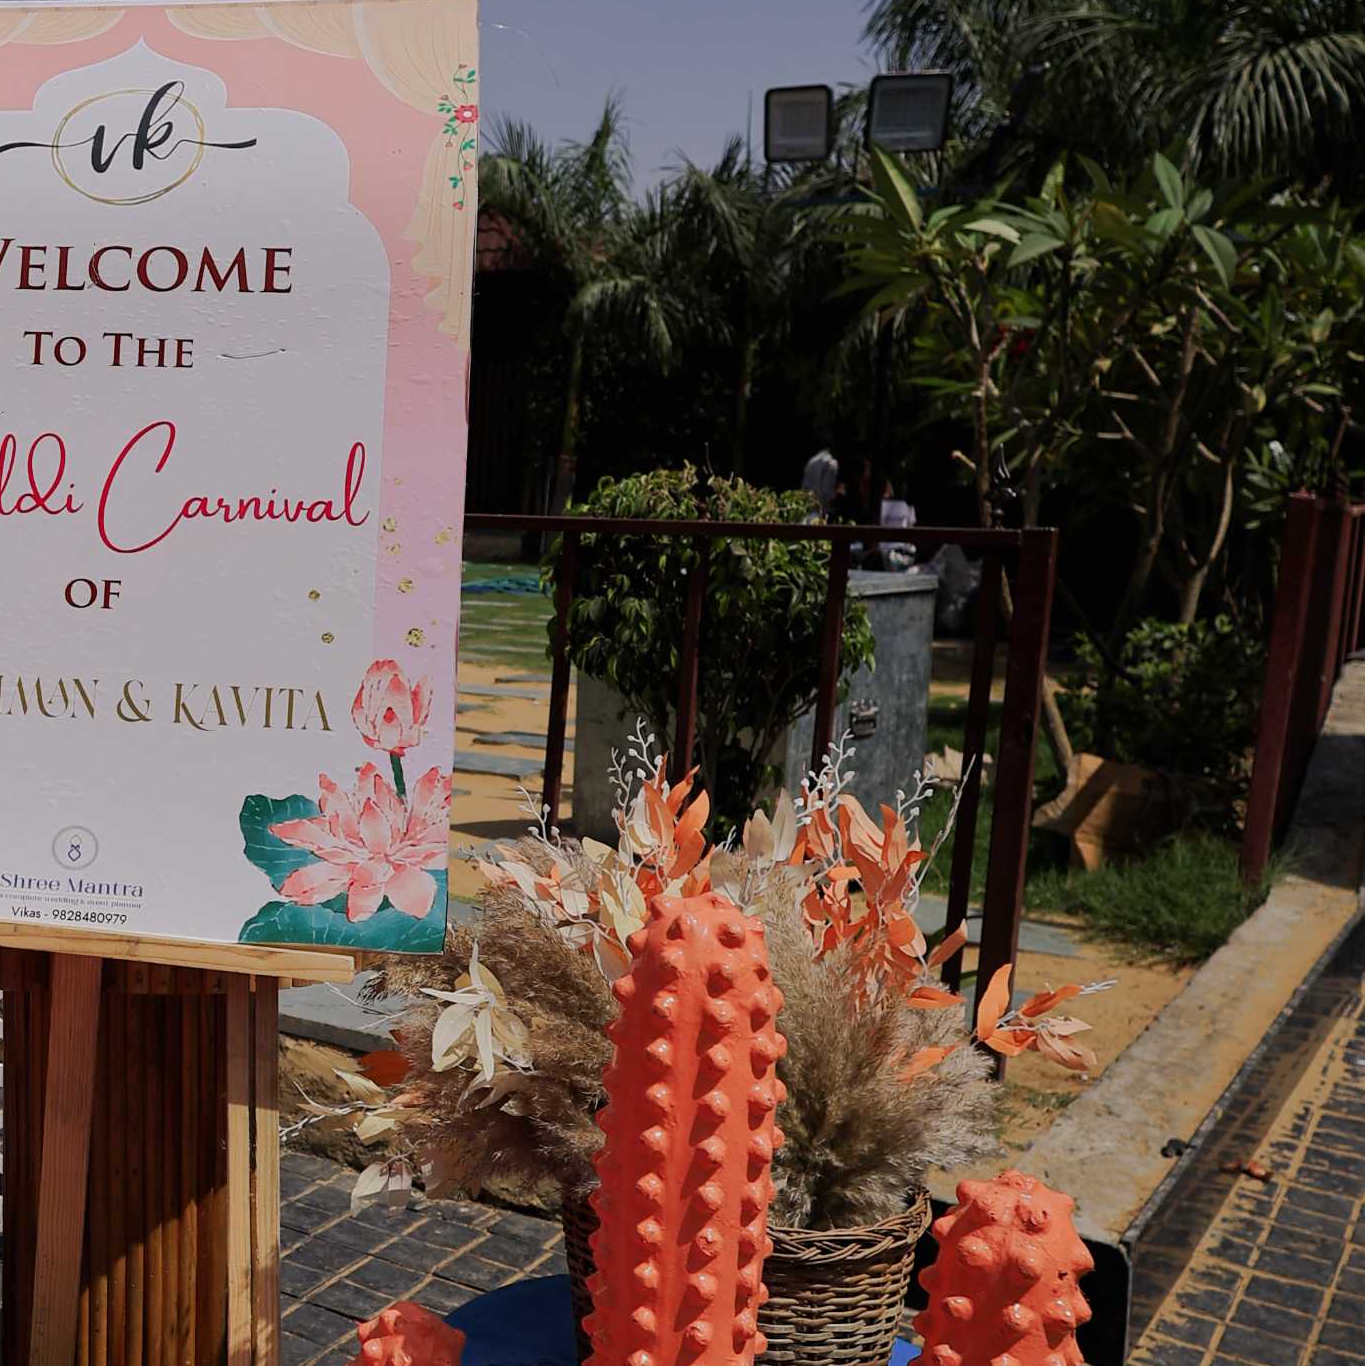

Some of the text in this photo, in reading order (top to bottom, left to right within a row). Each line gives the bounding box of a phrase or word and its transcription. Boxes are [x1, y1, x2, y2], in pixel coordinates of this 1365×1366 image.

[22, 330, 194, 369] TO THE
[97, 421, 371, 553] Carnival
[64, 578, 122, 610] OF
[115, 678, 153, 723] &
[172, 682, 335, 733] KAVITA
[0, 873, 144, 898] Shree Mantra
[11, 905, 42, 920] Vikas
[51, 908, 128, 925] 9828480979
